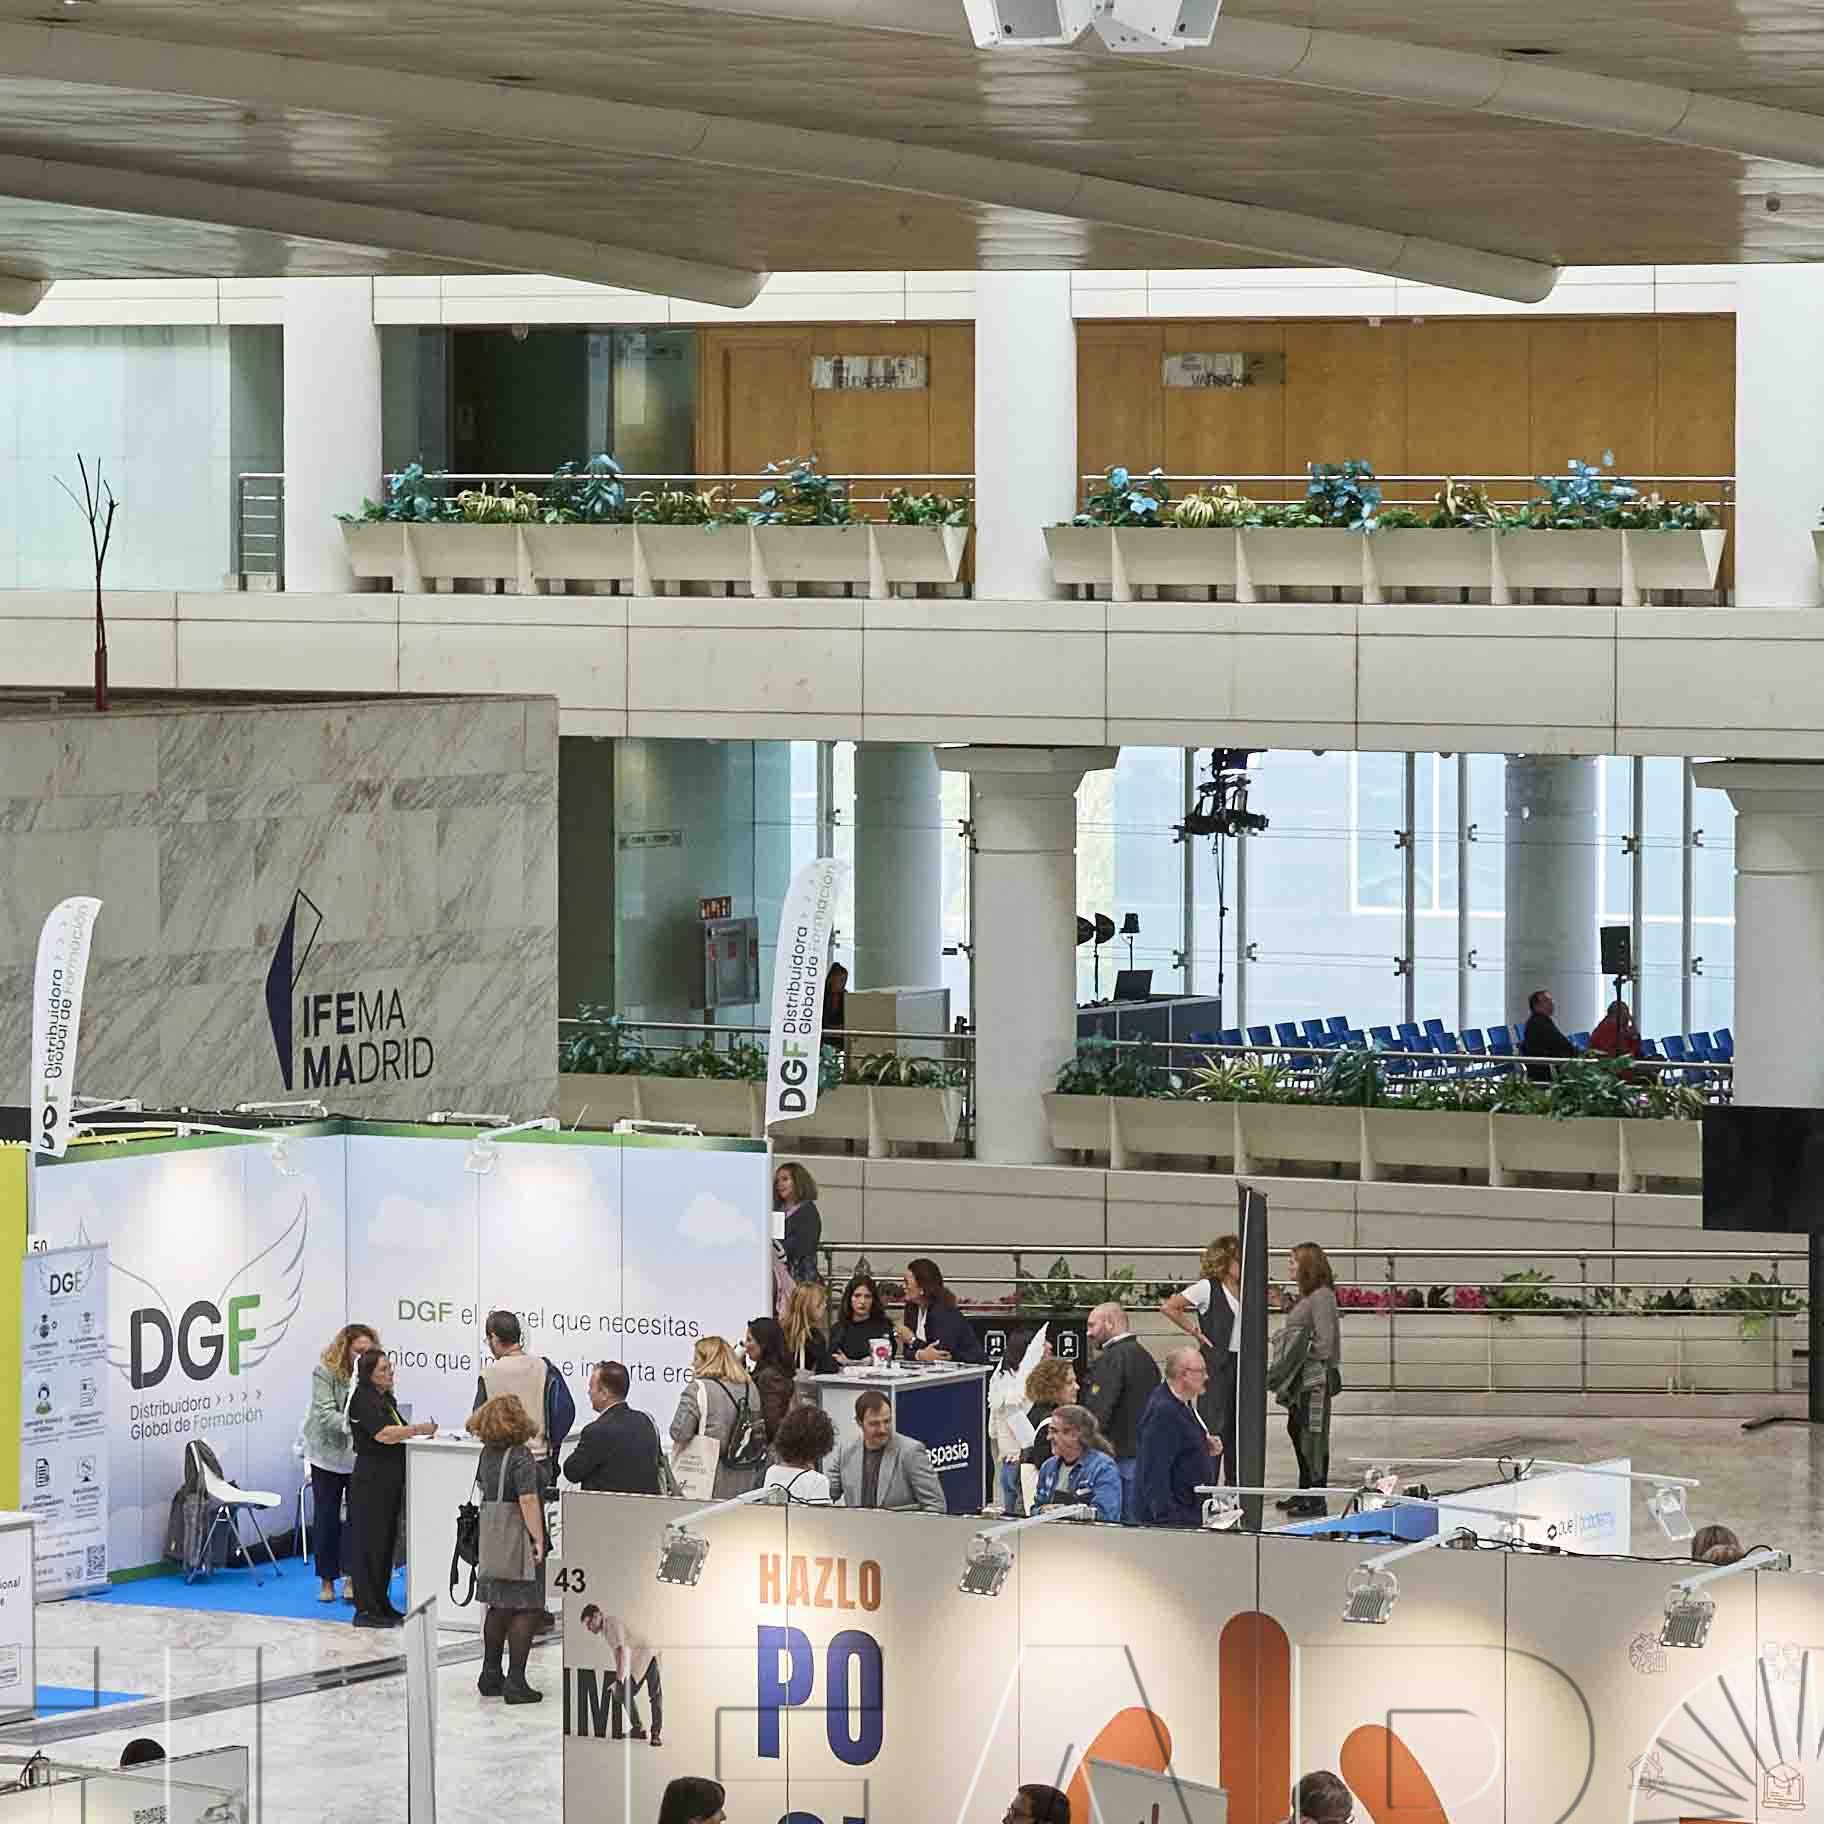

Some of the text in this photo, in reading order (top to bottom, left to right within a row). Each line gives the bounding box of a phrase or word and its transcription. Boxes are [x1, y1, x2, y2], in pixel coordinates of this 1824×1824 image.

[783, 926, 808, 1035] Distribuidora
[302, 988, 407, 1039] IFEMA
[799, 983, 817, 1036] Global
[302, 1037, 435, 1091] MADRID
[778, 1038, 809, 1113] DGF
[130, 1294, 262, 1391] DGF
[397, 1300, 455, 1324] DGF
[460, 1303, 479, 1326] el
[551, 1311, 594, 1334] que
[433, 1352, 472, 1377] que
[130, 1396, 212, 1421] Distribuidora
[130, 1418, 173, 1442] Global
[174, 1415, 192, 1435] de
[192, 1406, 264, 1433] Formación
[554, 1567, 587, 1593] 43
[757, 1553, 883, 1614] HAZLO
[756, 1623, 885, 1766] PO
